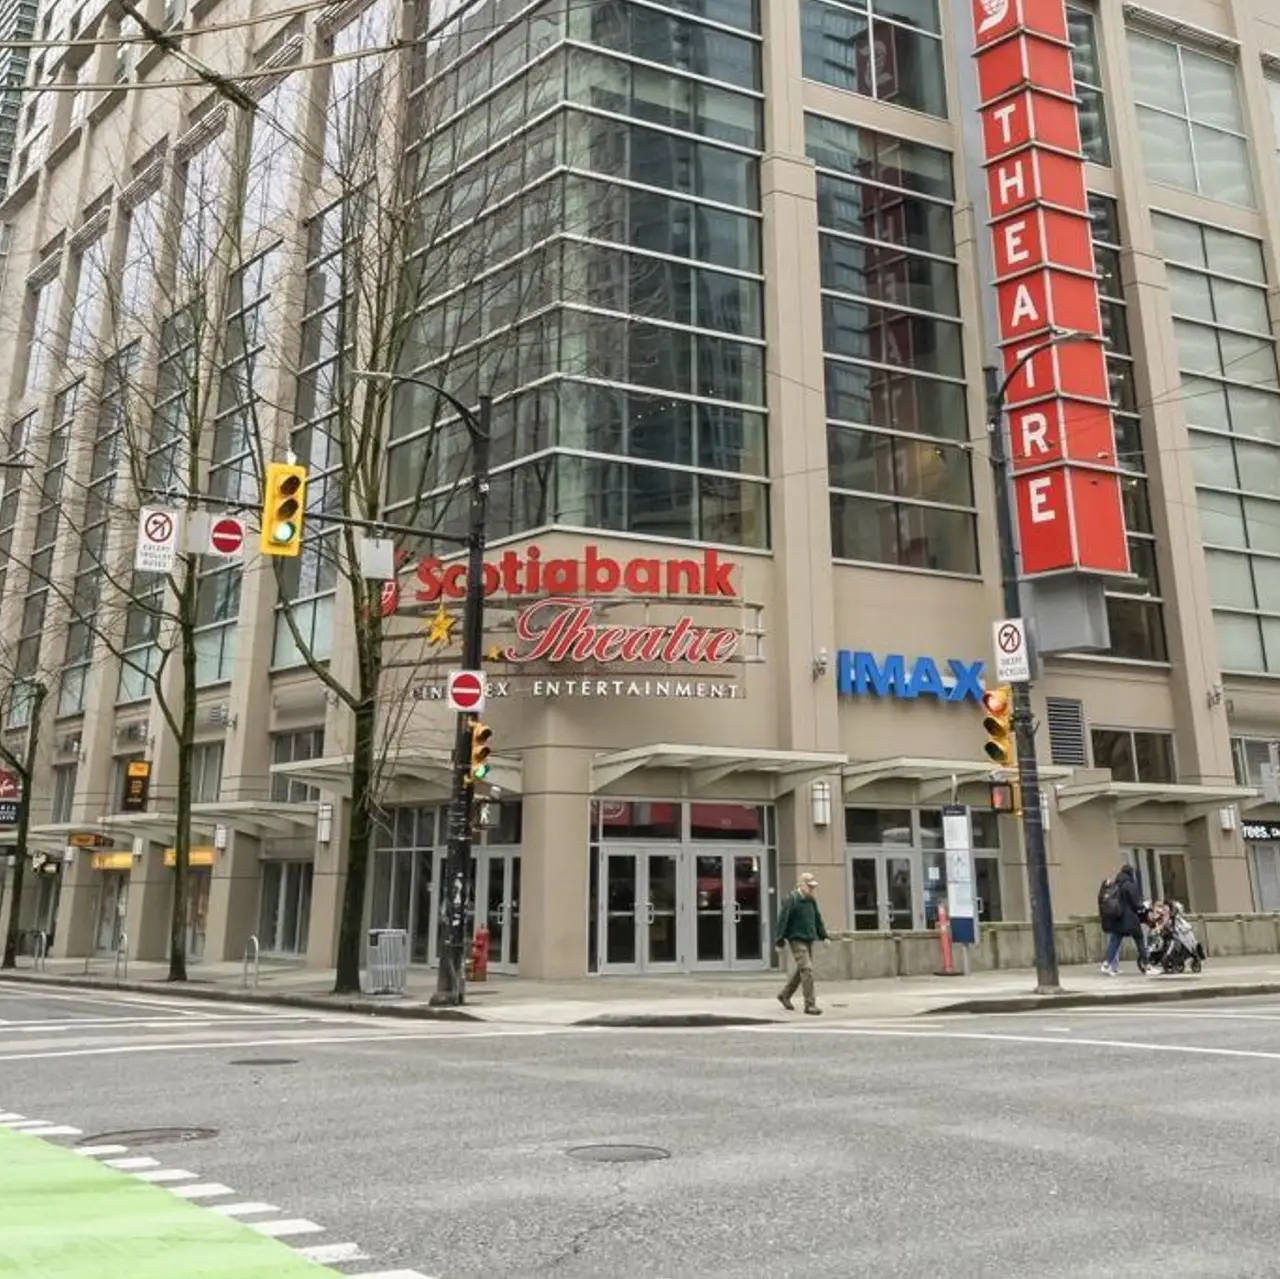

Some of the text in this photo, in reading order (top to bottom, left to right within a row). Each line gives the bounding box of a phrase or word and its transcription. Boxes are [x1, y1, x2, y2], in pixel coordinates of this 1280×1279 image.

[993, 101, 1056, 524] THEATRE
[414, 545, 737, 601] Scotiabank
[504, 597, 737, 664] Theatre
[533, 680, 739, 701] ENTERTAINMENT
[837, 650, 986, 703] IMAX
